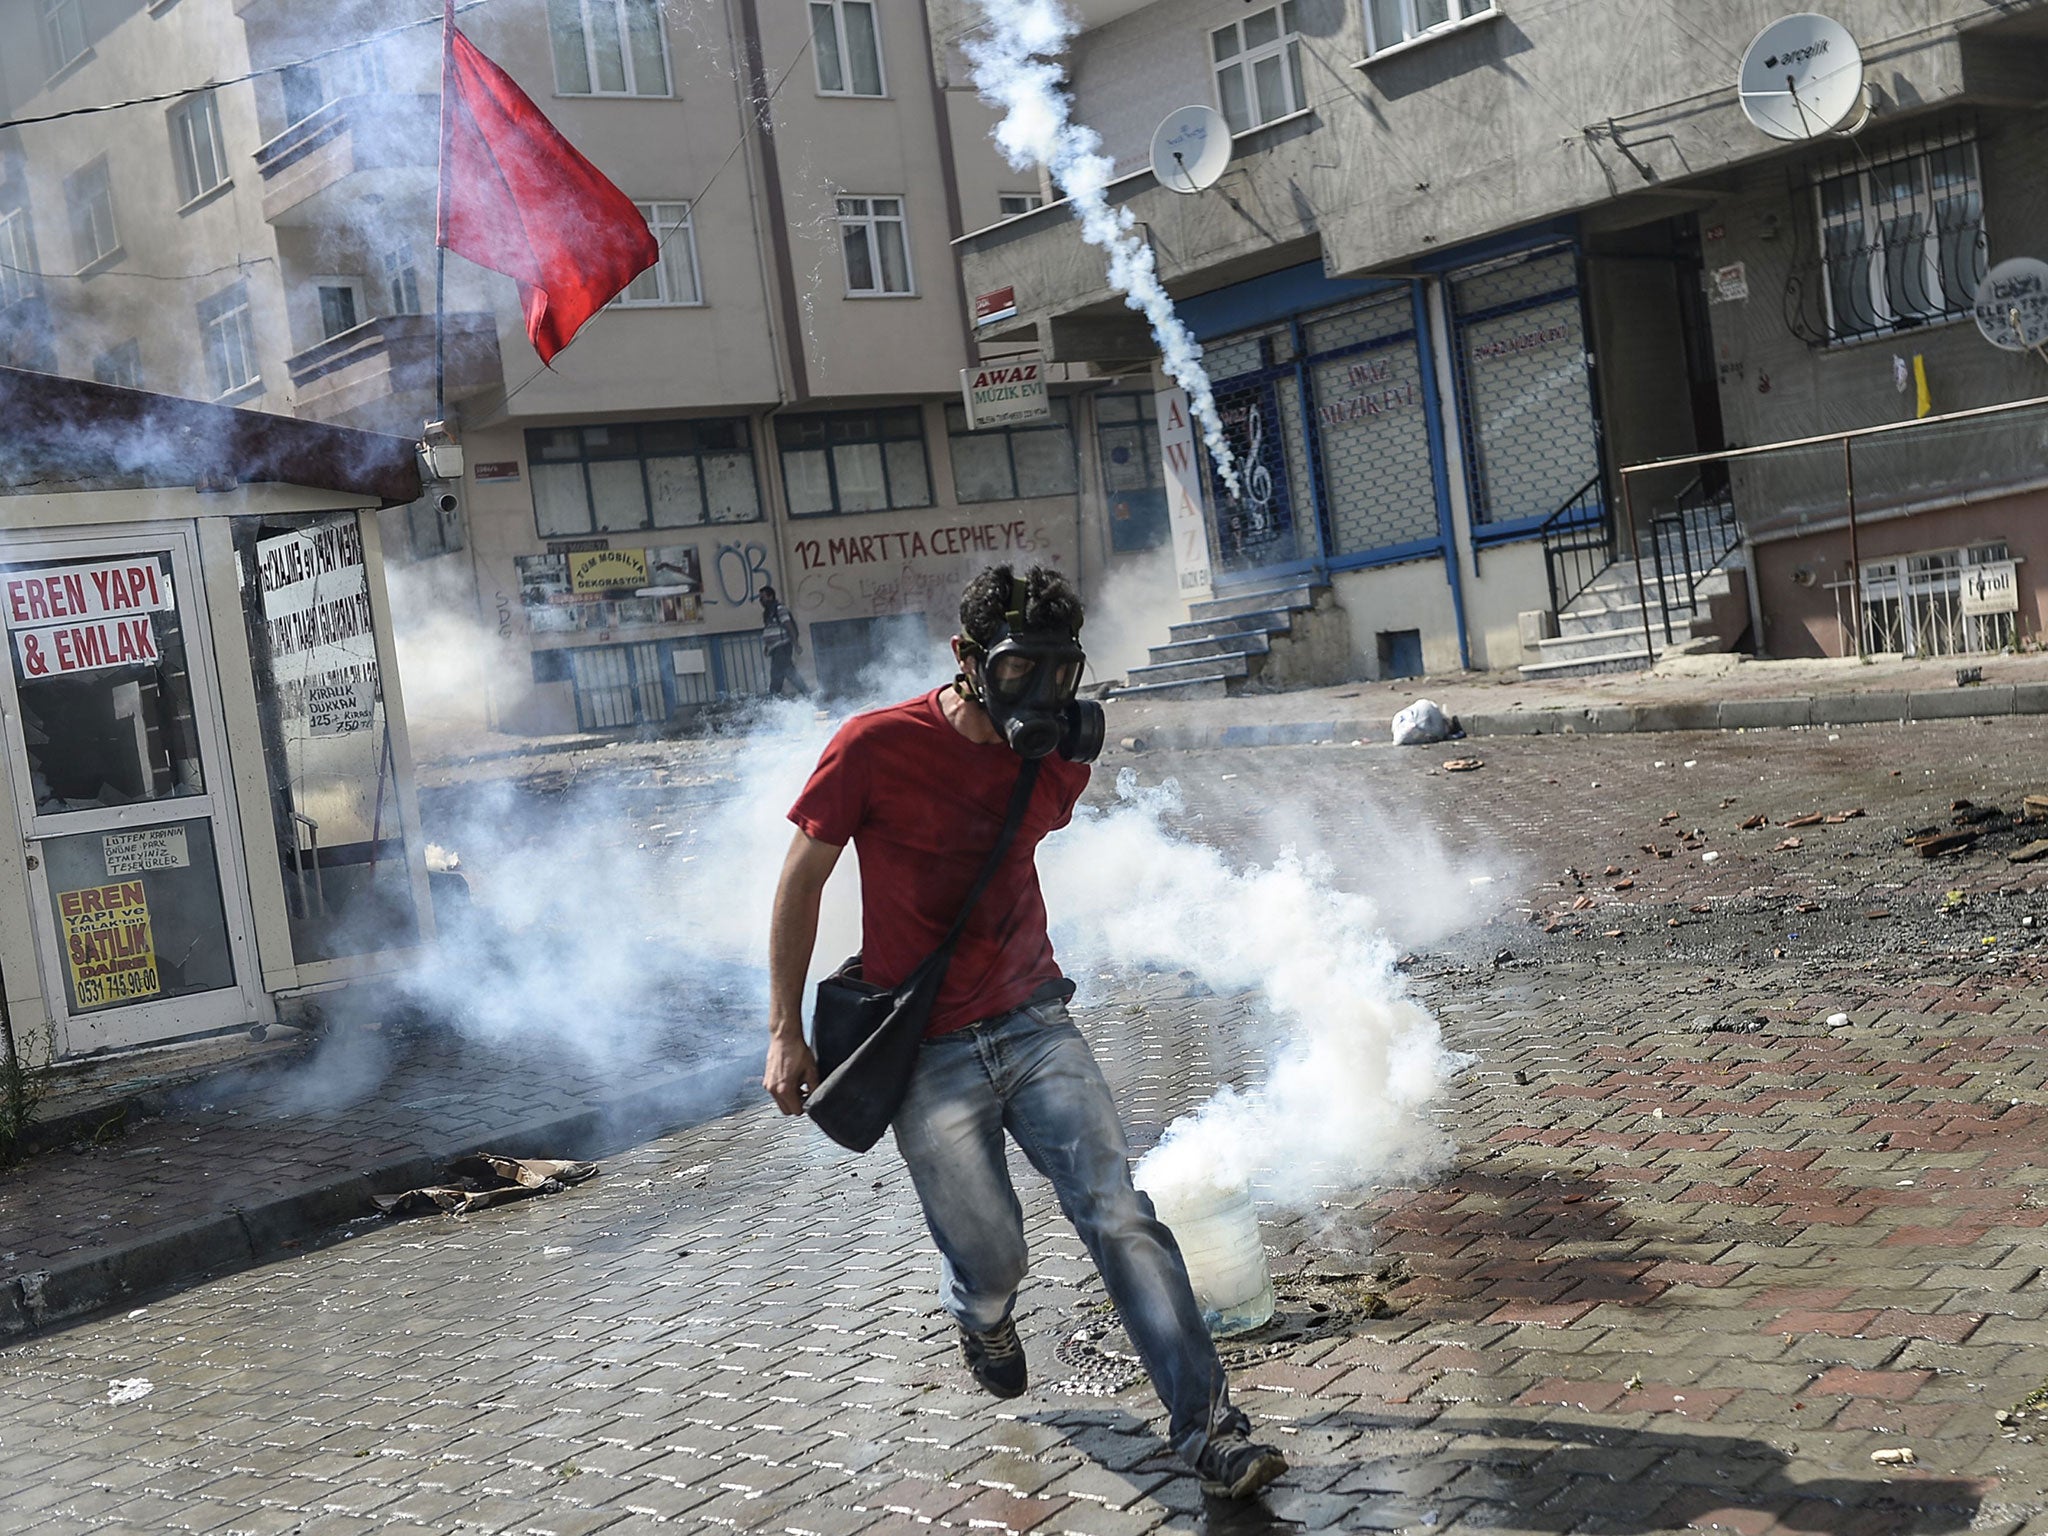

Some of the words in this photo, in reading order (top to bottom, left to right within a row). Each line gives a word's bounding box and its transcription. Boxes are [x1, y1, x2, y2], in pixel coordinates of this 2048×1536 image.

[973, 365, 1037, 388] AWAZ
[1166, 399, 1205, 563] AWAZ
[576, 558, 597, 579] TÜM
[598, 552, 644, 574] MOBİLYA
[795, 540, 826, 569] 12
[7, 574, 87, 622] EREN
[90, 566, 159, 611] YAPI
[578, 577, 646, 588] DEKORASYON
[24, 634, 49, 676] &
[53, 619, 156, 671] EMLAK
[310, 713, 331, 727] 125
[106, 833, 146, 846] LÜTFEN
[143, 839, 167, 849] PARK
[60, 882, 144, 917] EREN
[66, 910, 114, 926] YAPI
[121, 907, 145, 917] ve
[70, 917, 144, 934] EMLAK'tan
[70, 923, 151, 965] SATILIK
[78, 977, 105, 1004] 0531
